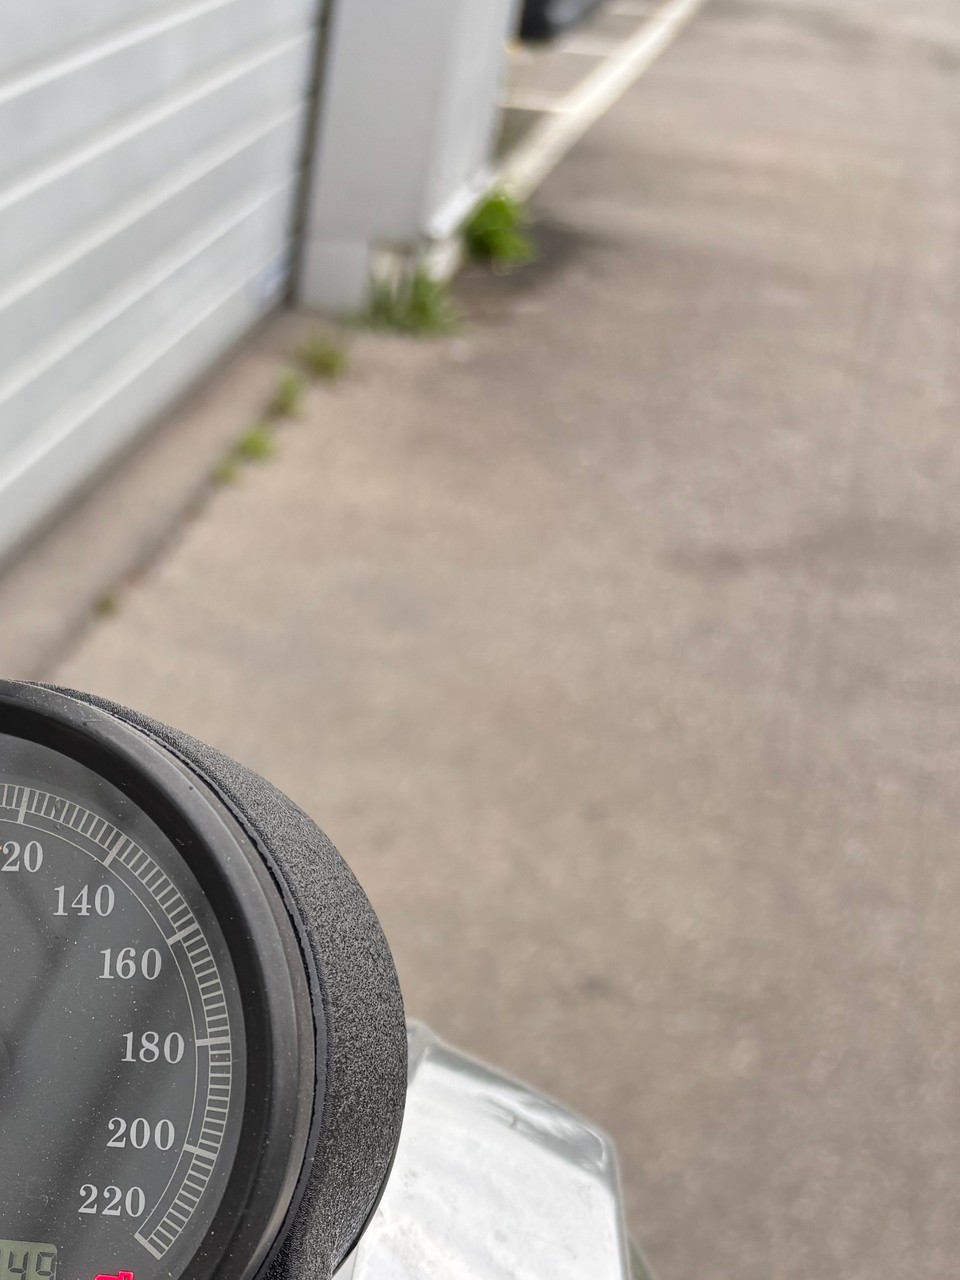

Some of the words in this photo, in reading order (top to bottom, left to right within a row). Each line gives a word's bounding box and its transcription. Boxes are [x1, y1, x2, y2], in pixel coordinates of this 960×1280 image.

[52, 884, 115, 917] 140
[98, 946, 162, 980] 160
[120, 1031, 185, 1064] 180
[106, 1117, 175, 1150] 200
[78, 1183, 146, 1218] 220
